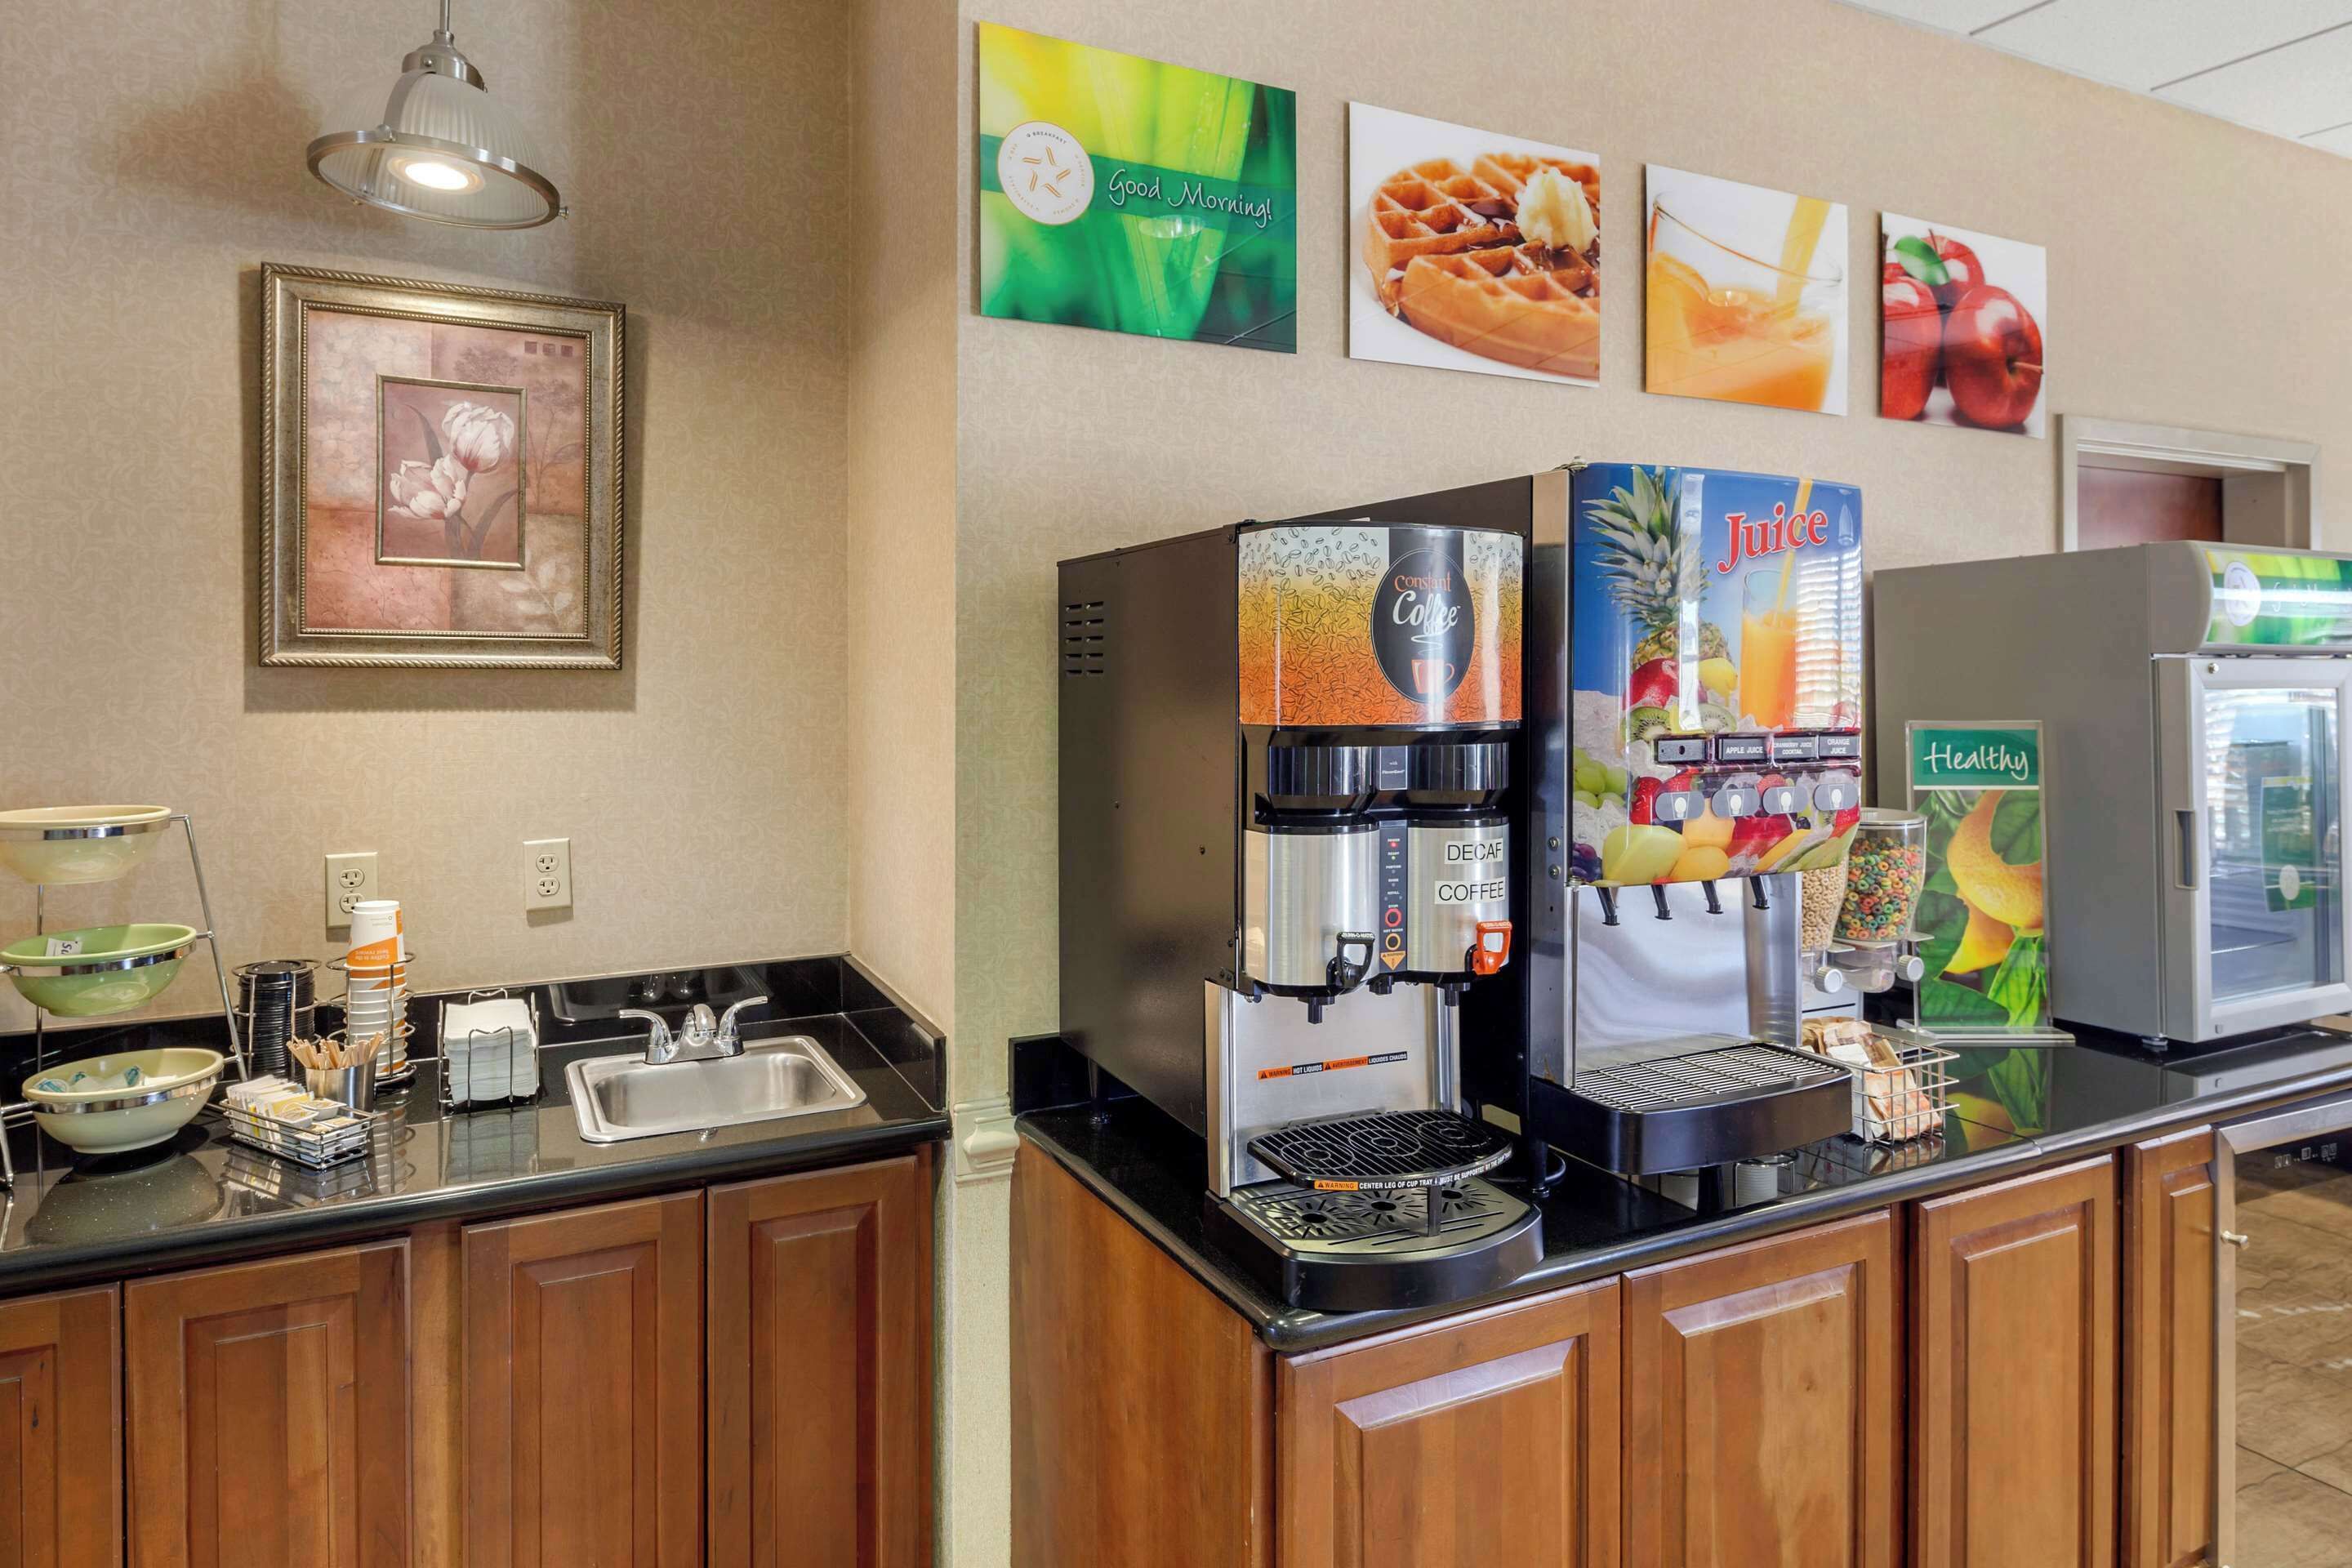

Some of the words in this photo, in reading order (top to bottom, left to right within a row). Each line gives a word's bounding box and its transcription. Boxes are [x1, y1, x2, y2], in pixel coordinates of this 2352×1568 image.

[1109, 169, 1162, 206] Good
[1168, 181, 1272, 229] Morning!
[1717, 501, 1829, 574] Juice
[1394, 570, 1451, 592] Constant
[1392, 590, 1459, 635] Coffee
[1747, 746, 1763, 754] JUICE
[1923, 742, 2029, 781] Healthy
[1447, 842, 1502, 861] DECAF
[1439, 881, 1504, 901] COFFEE
[1268, 1070, 1291, 1078] WARNING
[1440, 1176, 1453, 1185] MUST
